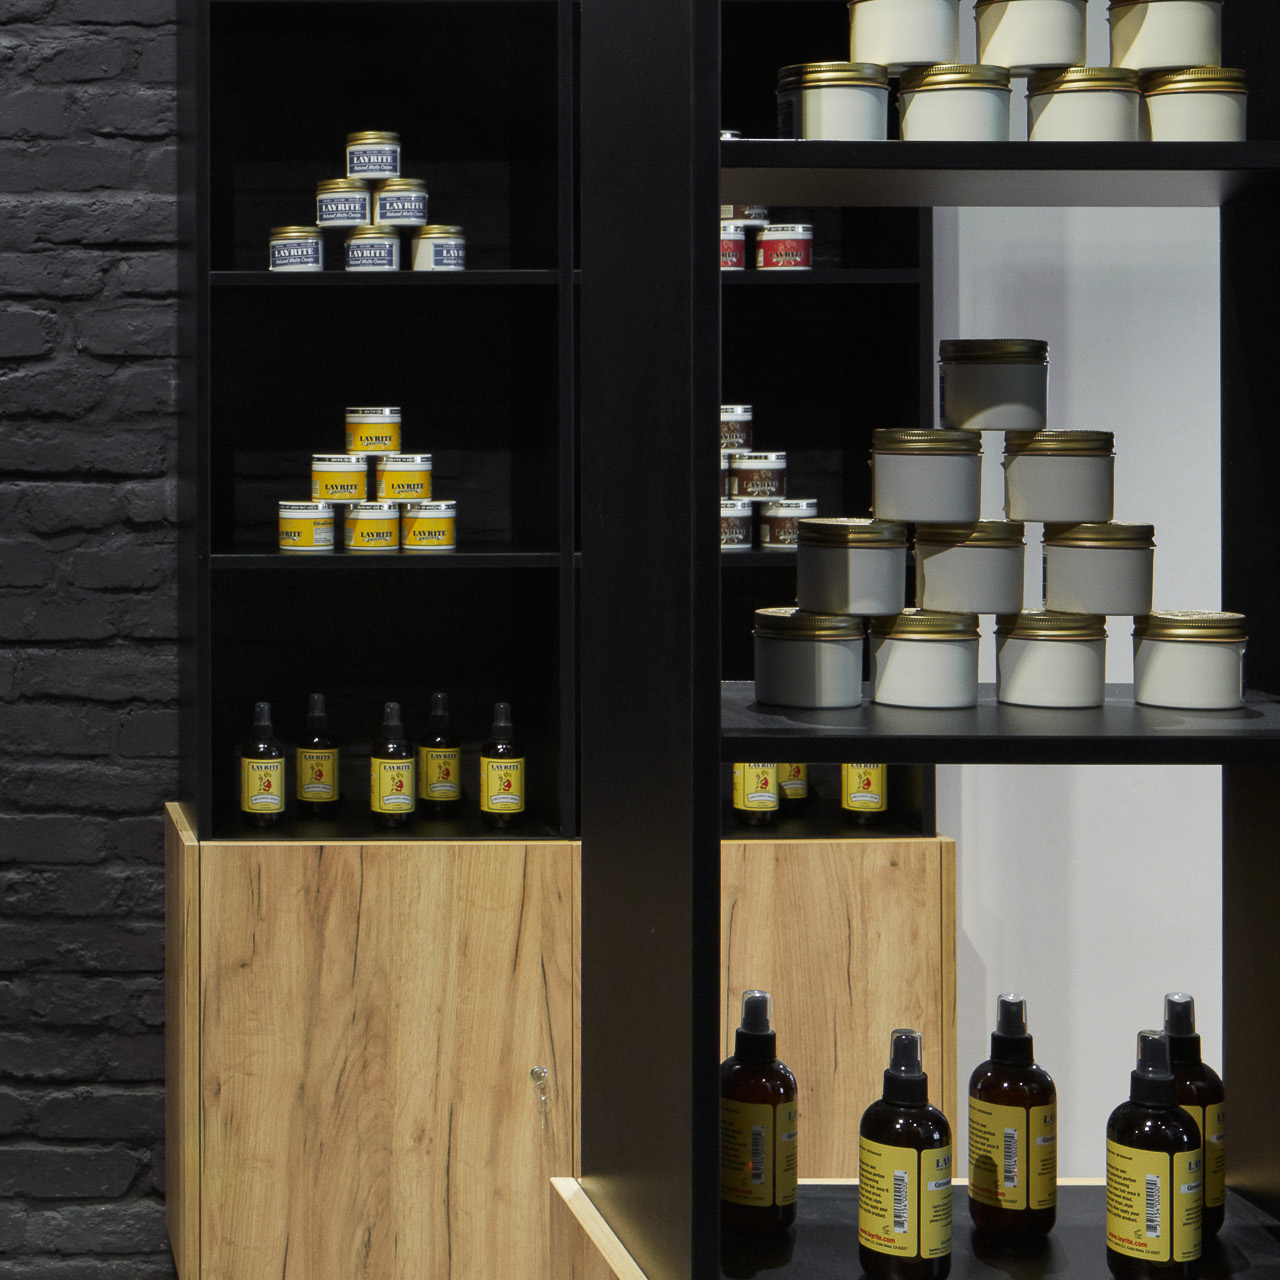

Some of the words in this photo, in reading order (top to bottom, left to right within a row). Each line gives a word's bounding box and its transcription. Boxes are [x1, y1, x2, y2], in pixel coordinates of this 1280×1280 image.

[353, 155, 393, 164] LAYRITE
[322, 203, 361, 211] LAYRITE
[275, 248, 314, 257] LAYRITE
[349, 249, 387, 258] LAYRITE
[442, 249, 465, 257] LAYR
